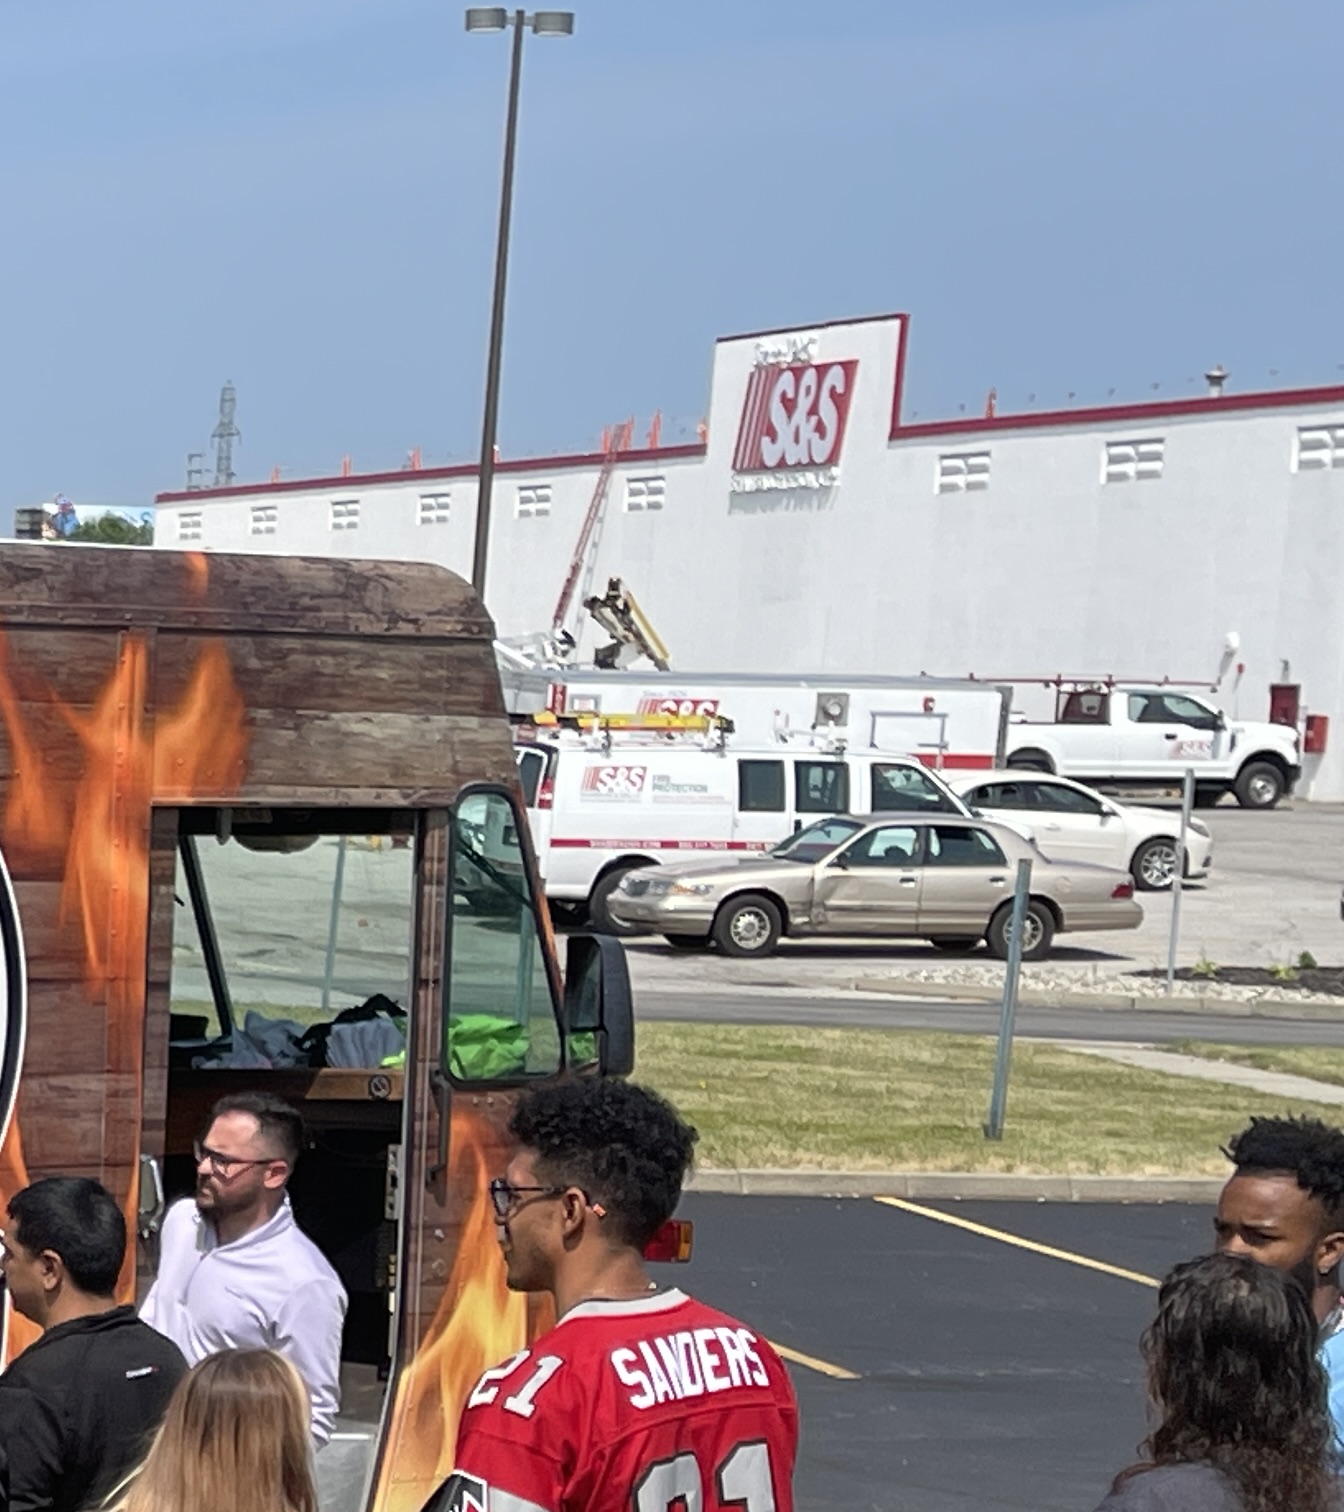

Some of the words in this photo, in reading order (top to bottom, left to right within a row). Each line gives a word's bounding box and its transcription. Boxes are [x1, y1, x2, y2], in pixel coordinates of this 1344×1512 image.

[761, 365, 845, 467] S&S
[596, 766, 645, 794] S&S
[467, 1349, 564, 1418] 21
[611, 1327, 770, 1410] SANDERS
